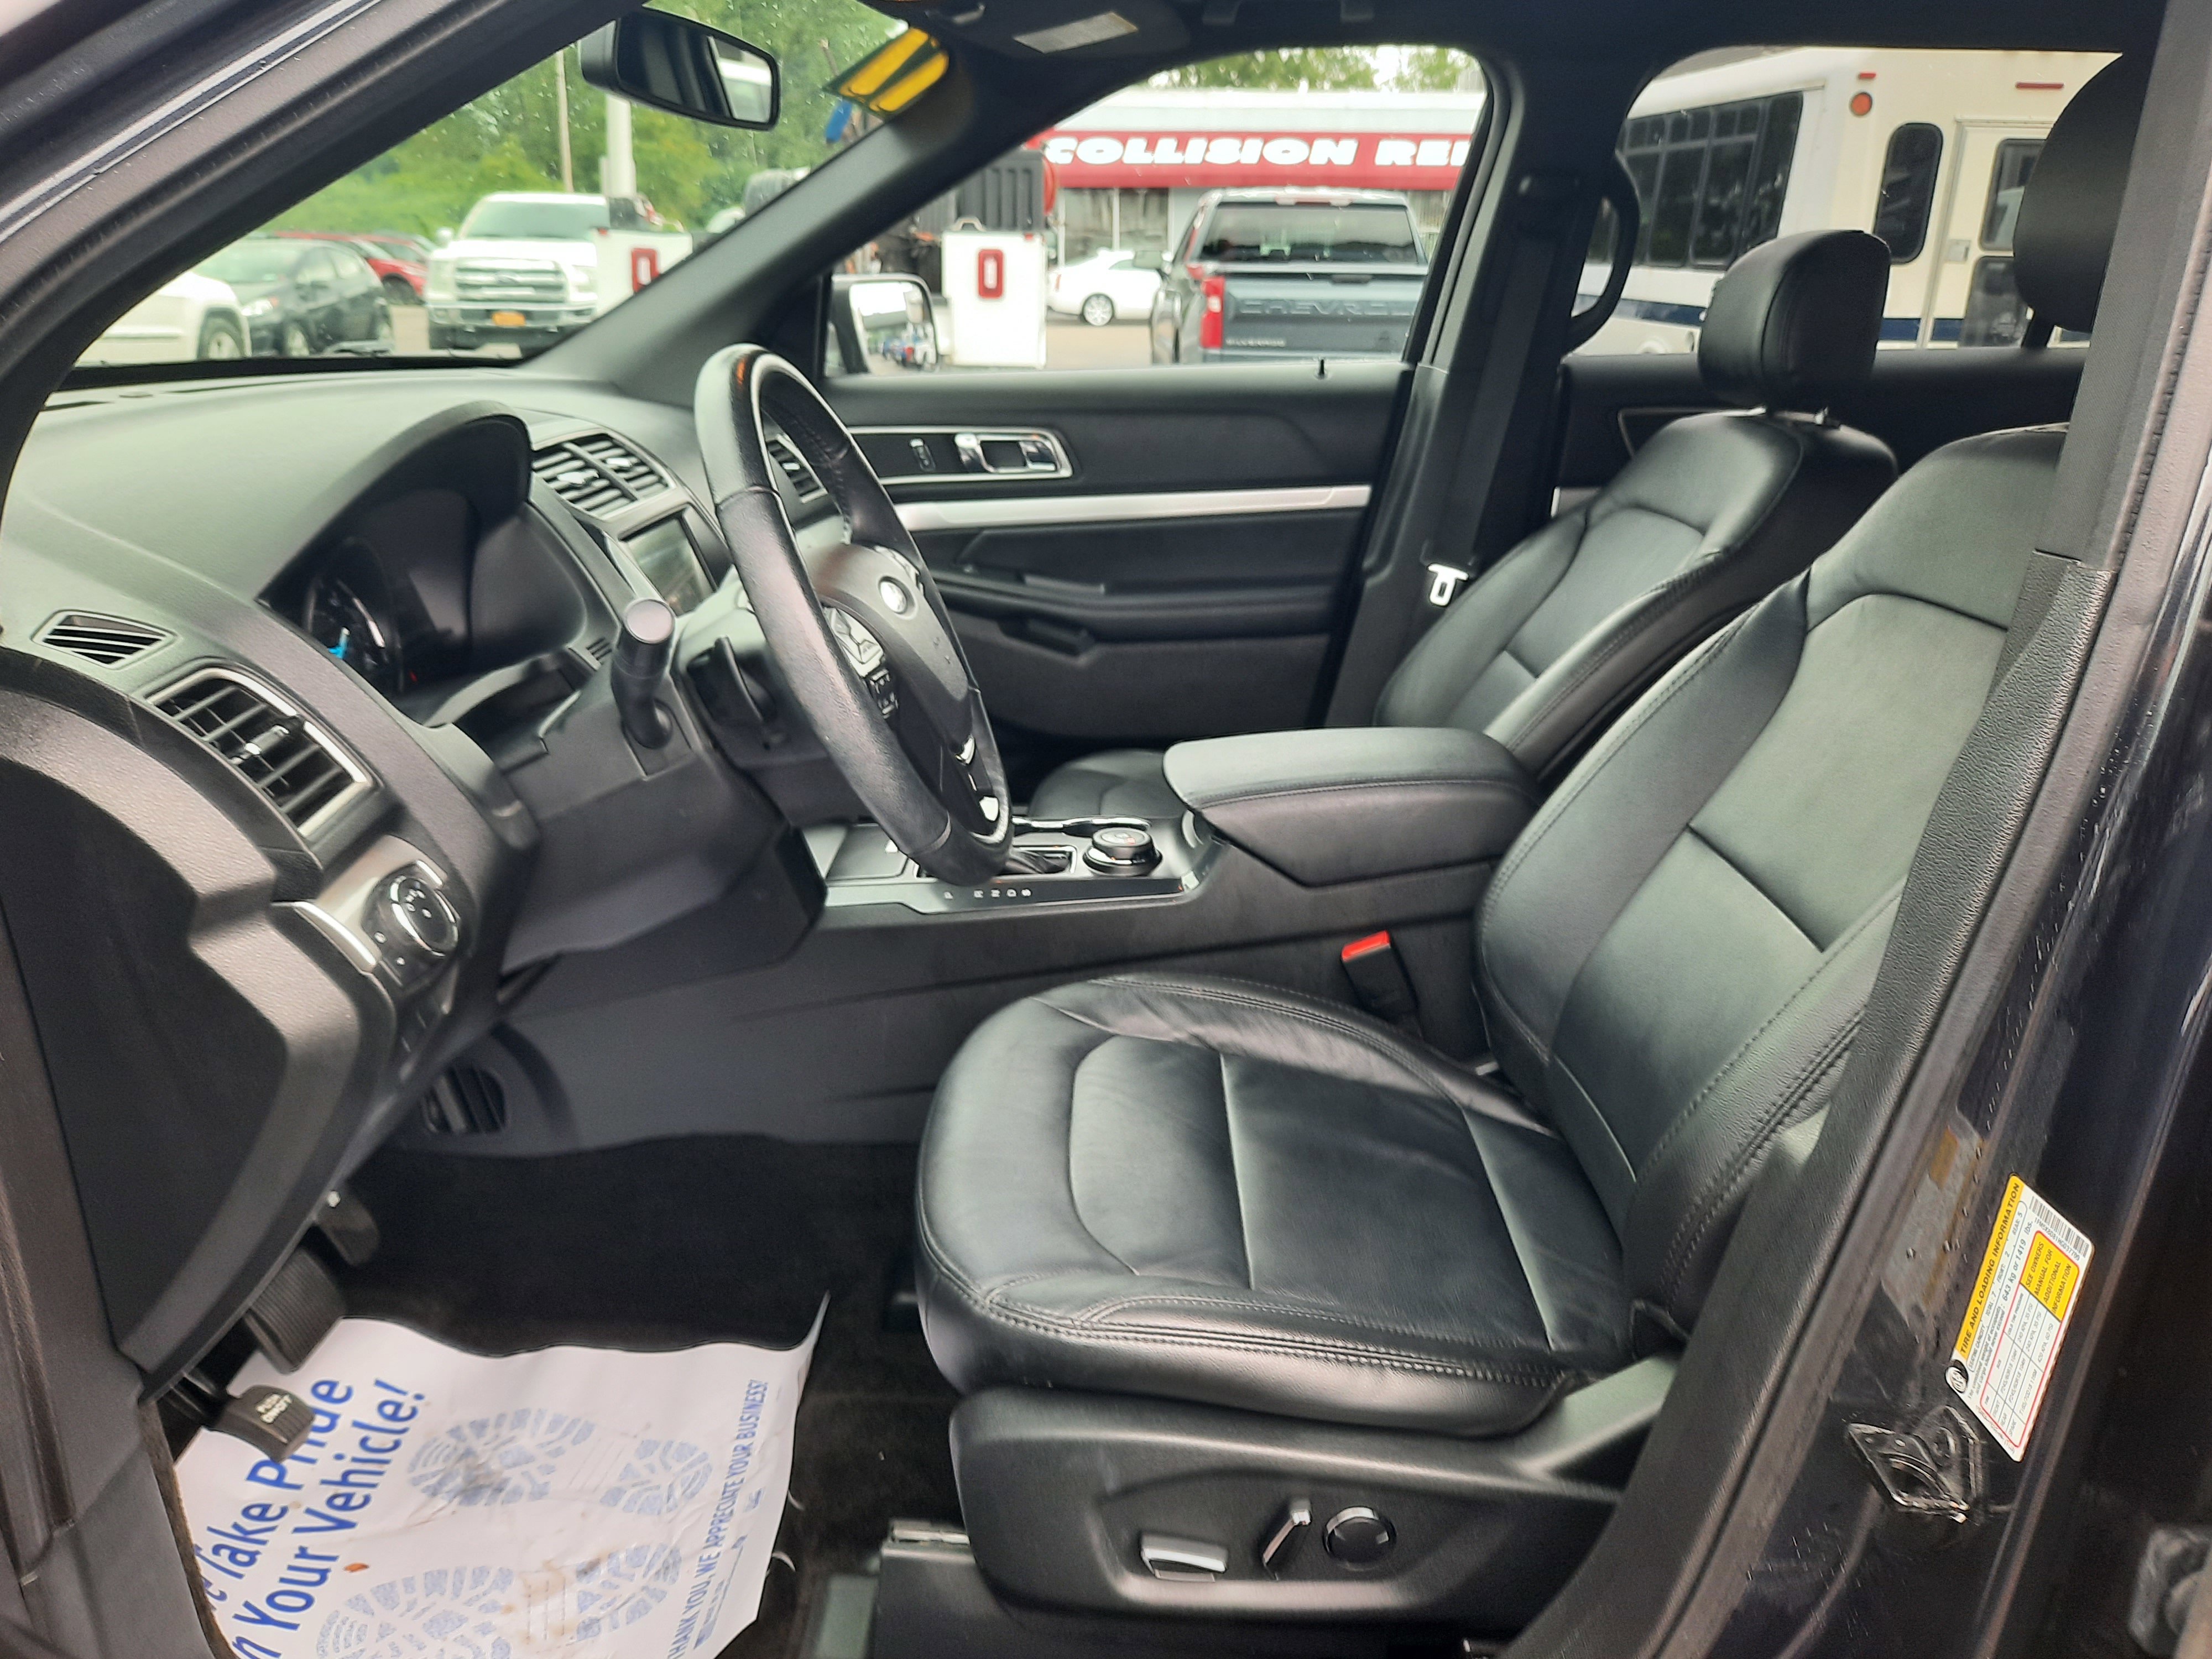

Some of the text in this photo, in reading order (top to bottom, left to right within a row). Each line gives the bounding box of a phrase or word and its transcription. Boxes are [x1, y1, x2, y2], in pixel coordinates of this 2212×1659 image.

[1044, 136, 1358, 165] COLLISION
[1961, 1183, 2020, 1353] TIRE AND LOADING INFORMATION
[2002, 1284, 2012, 1301] 643
[2008, 1272, 2017, 1284] kg
[2013, 1260, 2019, 1271] or
[2016, 1239, 2027, 1260] 1419
[2031, 1241, 2044, 1272] OWNERS
[2034, 1249, 2053, 1296] MANUAL FOR
[2044, 1261, 2062, 1303] ADDITIONAL
[2052, 1264, 2072, 1313] INFORMATION
[736, 1379, 768, 1439] BUSINESS!
[725, 1441, 754, 1479] YOUR
[232, 1546, 340, 1631] Your
[291, 1378, 425, 1534] Vehicle!
[702, 1477, 745, 1549] APPRECIATE
[194, 1502, 289, 1579] Take
[695, 1552, 721, 1578] WE
